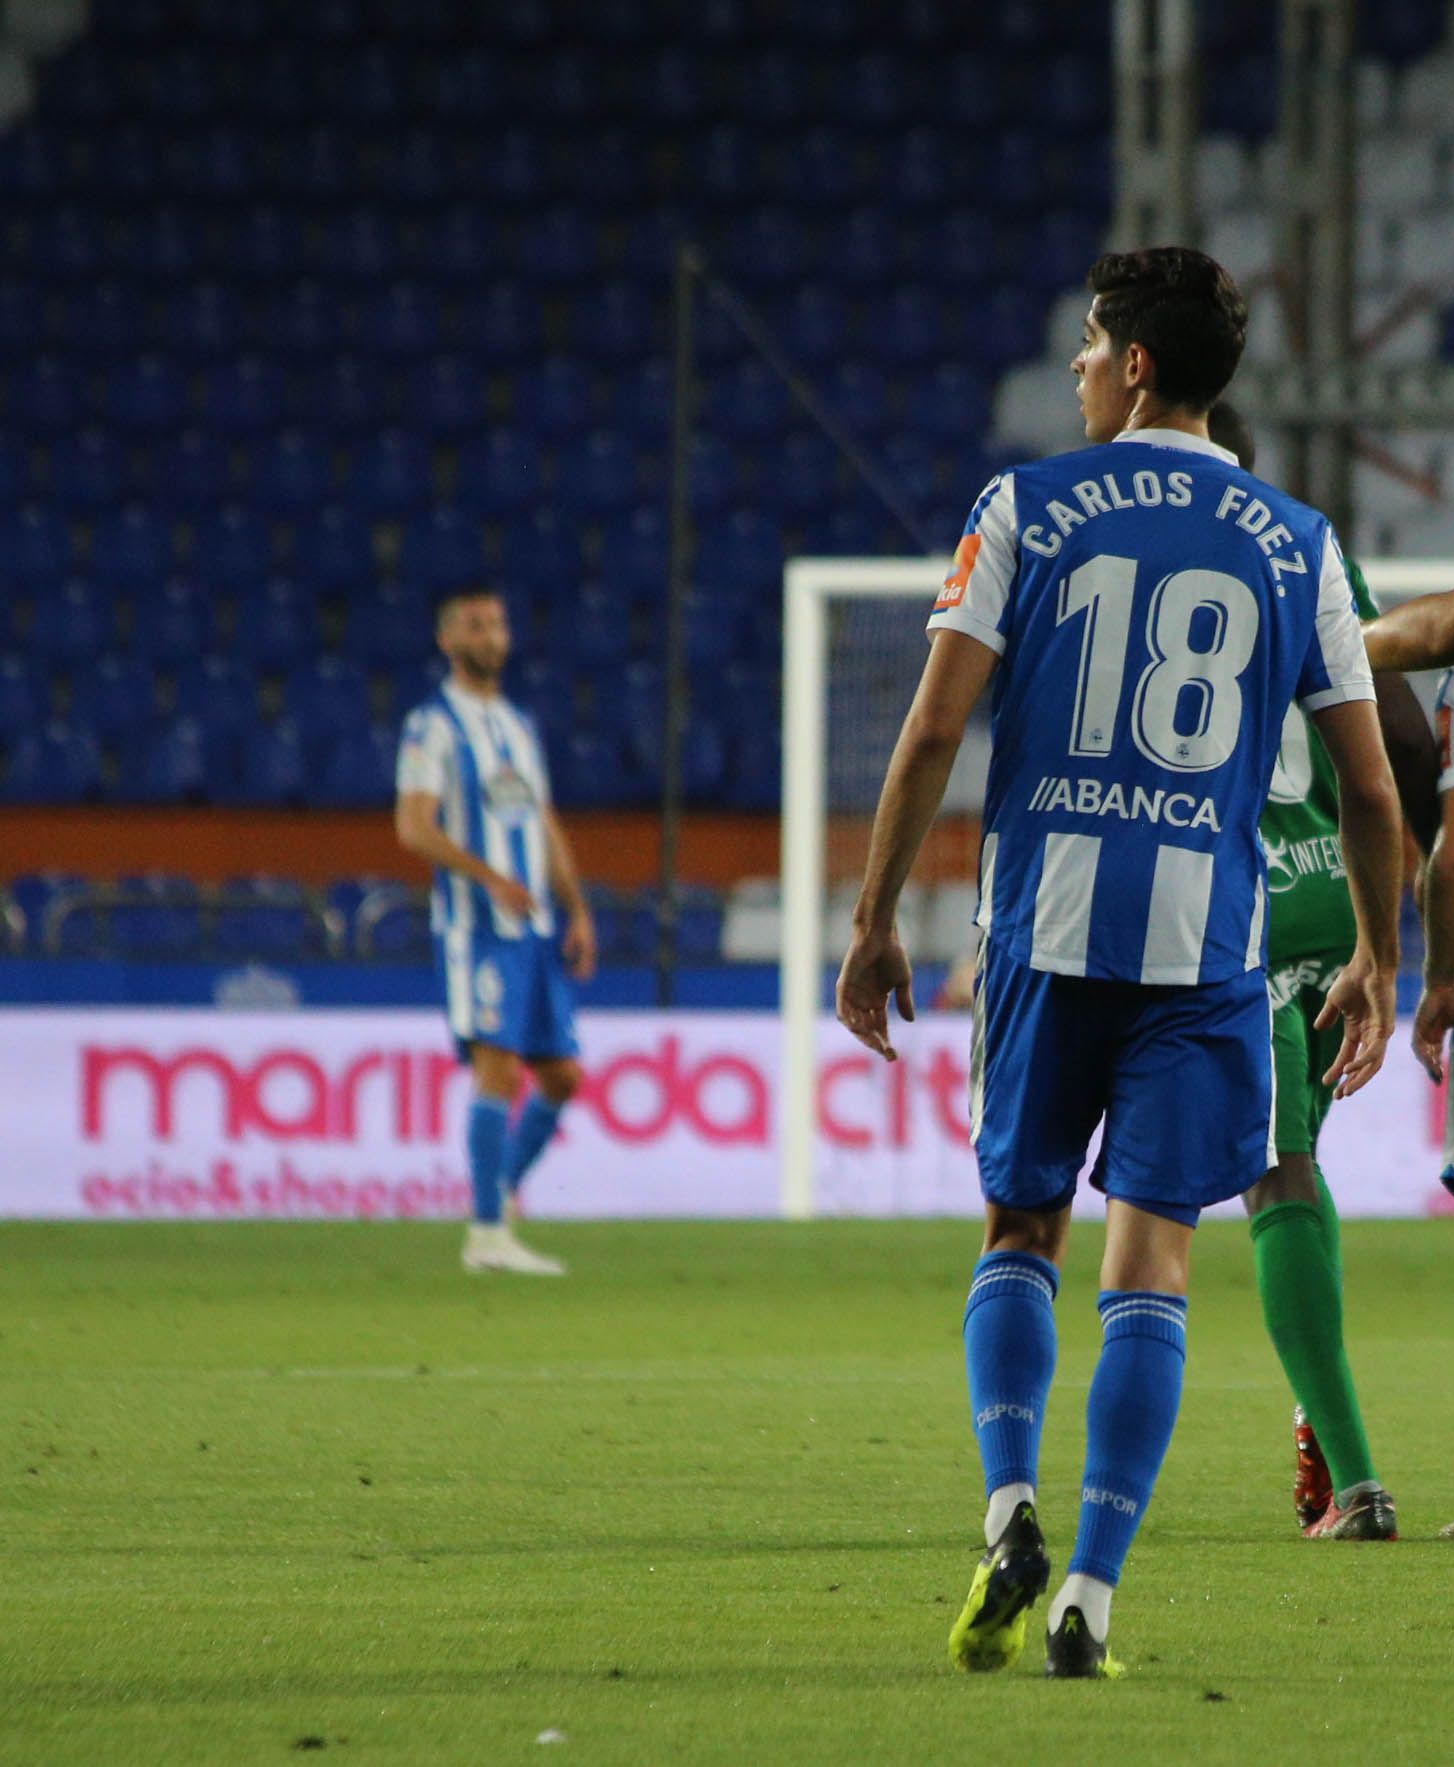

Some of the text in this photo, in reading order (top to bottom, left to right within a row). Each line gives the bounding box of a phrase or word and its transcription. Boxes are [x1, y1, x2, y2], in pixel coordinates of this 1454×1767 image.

[1021, 470, 1308, 598] CARLOS FDEZ.
[1056, 554, 1260, 773] 18
[976, 1403, 1036, 1429] DEPOR
[1083, 1487, 1138, 1516] DEPOR
